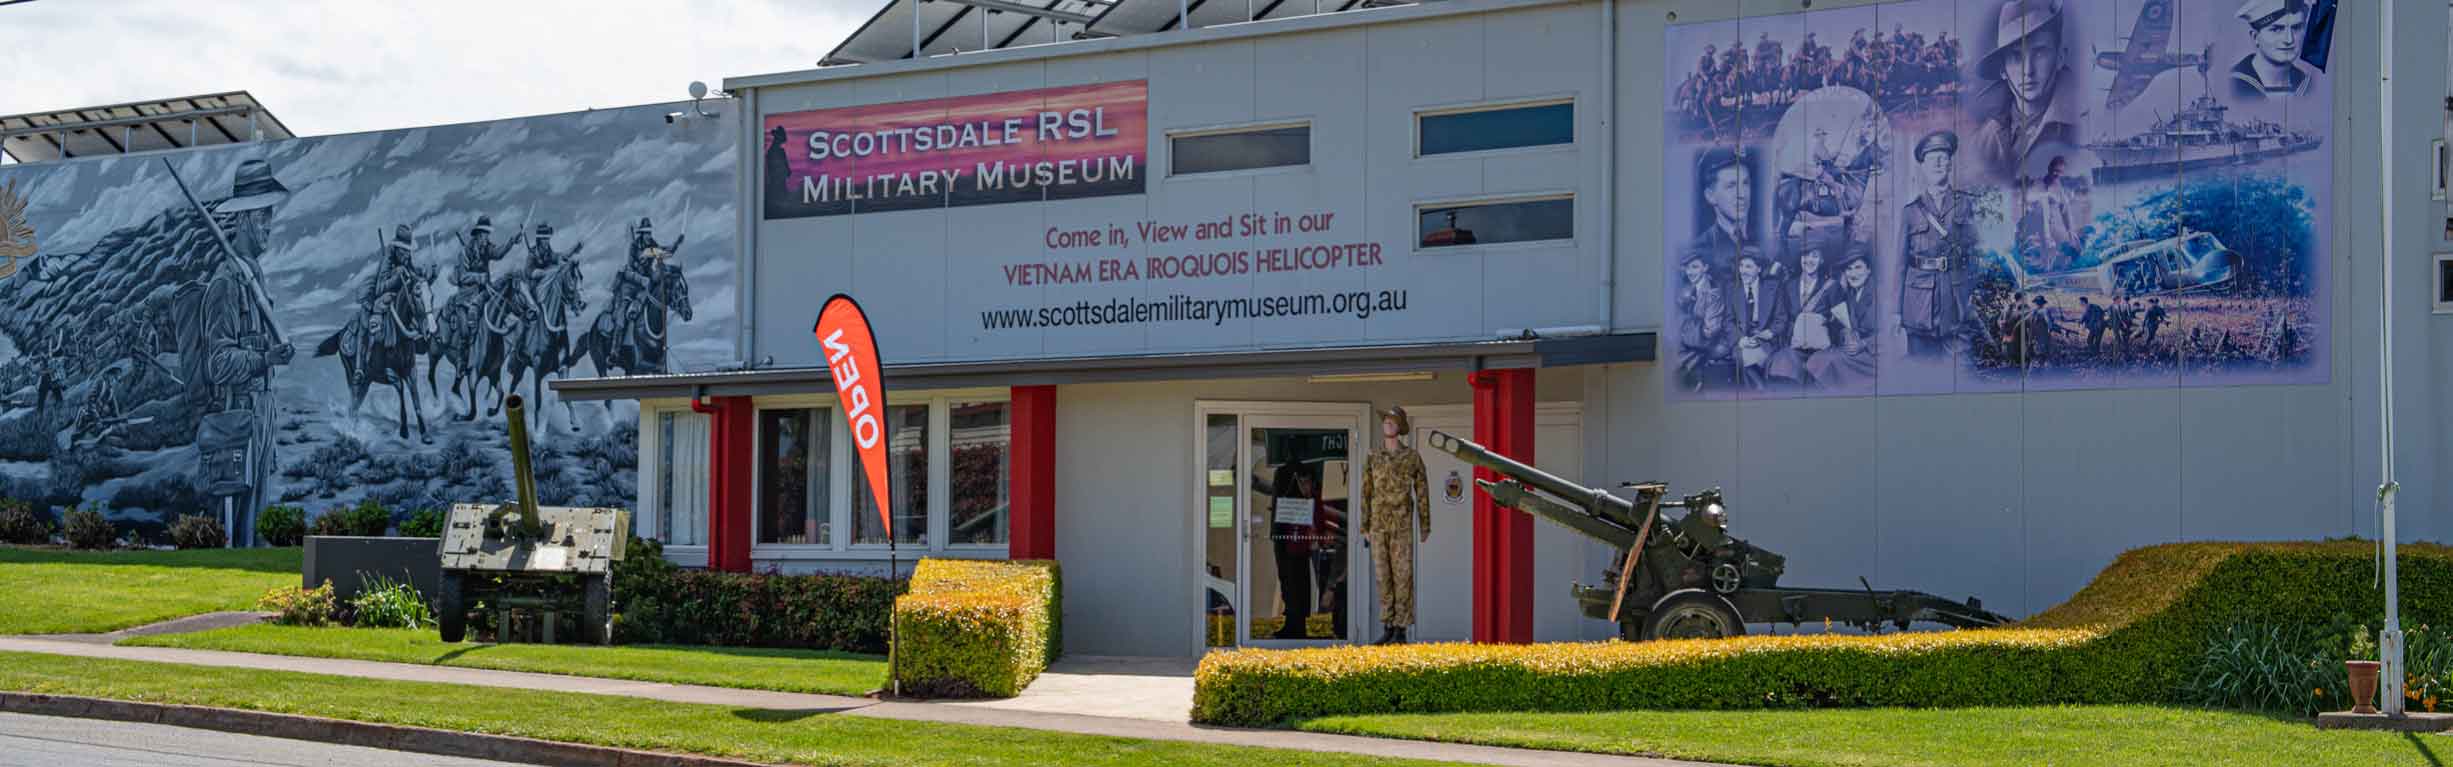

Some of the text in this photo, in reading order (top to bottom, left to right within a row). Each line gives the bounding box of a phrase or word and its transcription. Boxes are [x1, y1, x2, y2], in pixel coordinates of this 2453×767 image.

[809, 106, 1118, 160] SCOTTSDALE RSL
[803, 155, 1134, 203] MILITARY MUSEUM
[1046, 211, 1334, 249] Come in, View and Sit in our
[1004, 243, 1383, 286] VIETNAM ERA IROQUOIS HELICOPTER
[981, 289, 1407, 330] www.scottsdalemilitarymuseum.org.au
